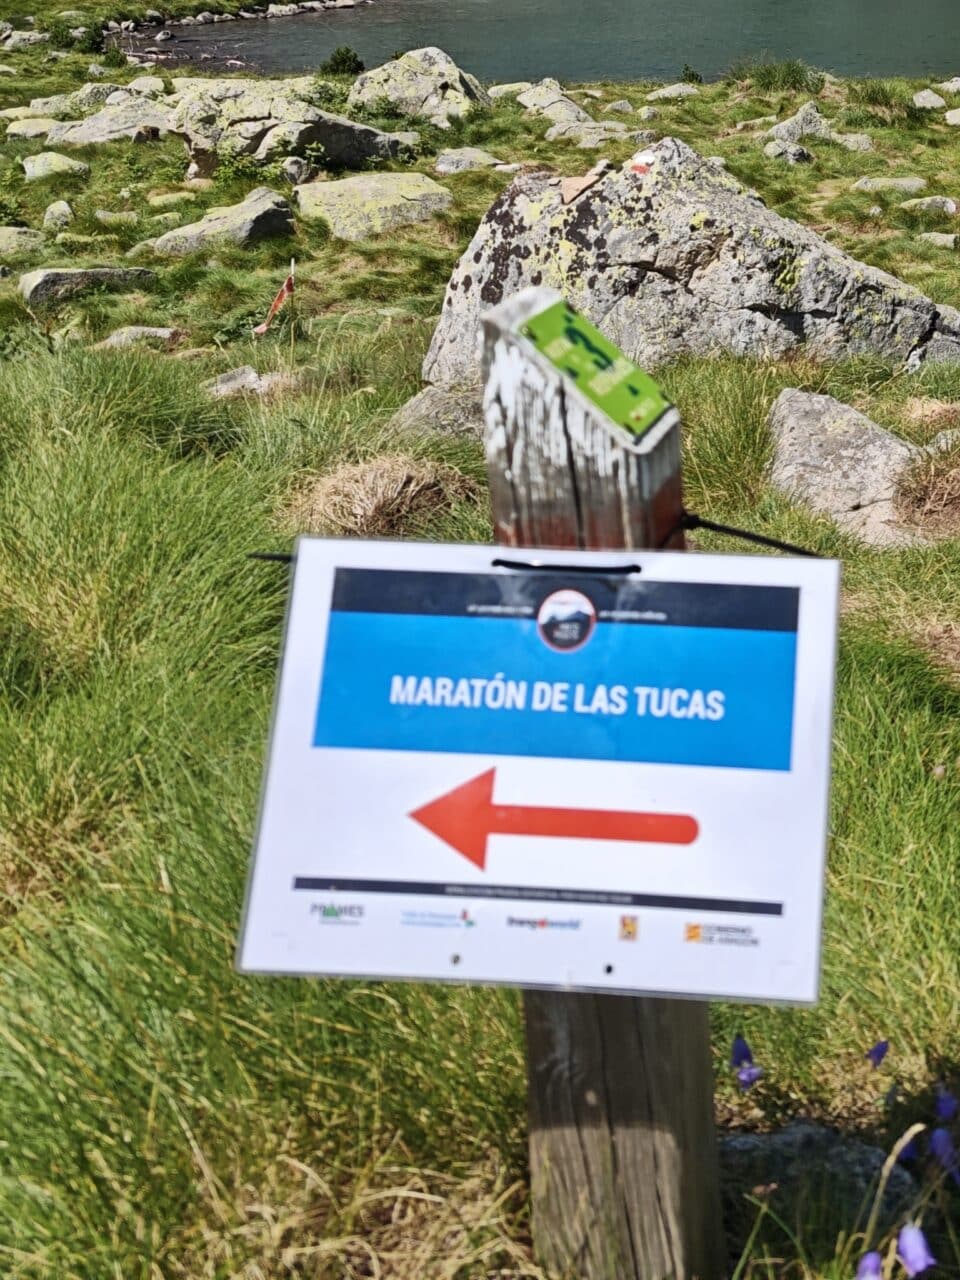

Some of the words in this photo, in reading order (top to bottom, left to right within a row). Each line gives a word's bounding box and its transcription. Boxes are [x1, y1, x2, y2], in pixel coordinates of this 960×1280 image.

[389, 672, 528, 710] MARATÓN
[531, 681, 570, 713] DE
[574, 684, 628, 716] LAS
[634, 686, 726, 720] TUCAS
